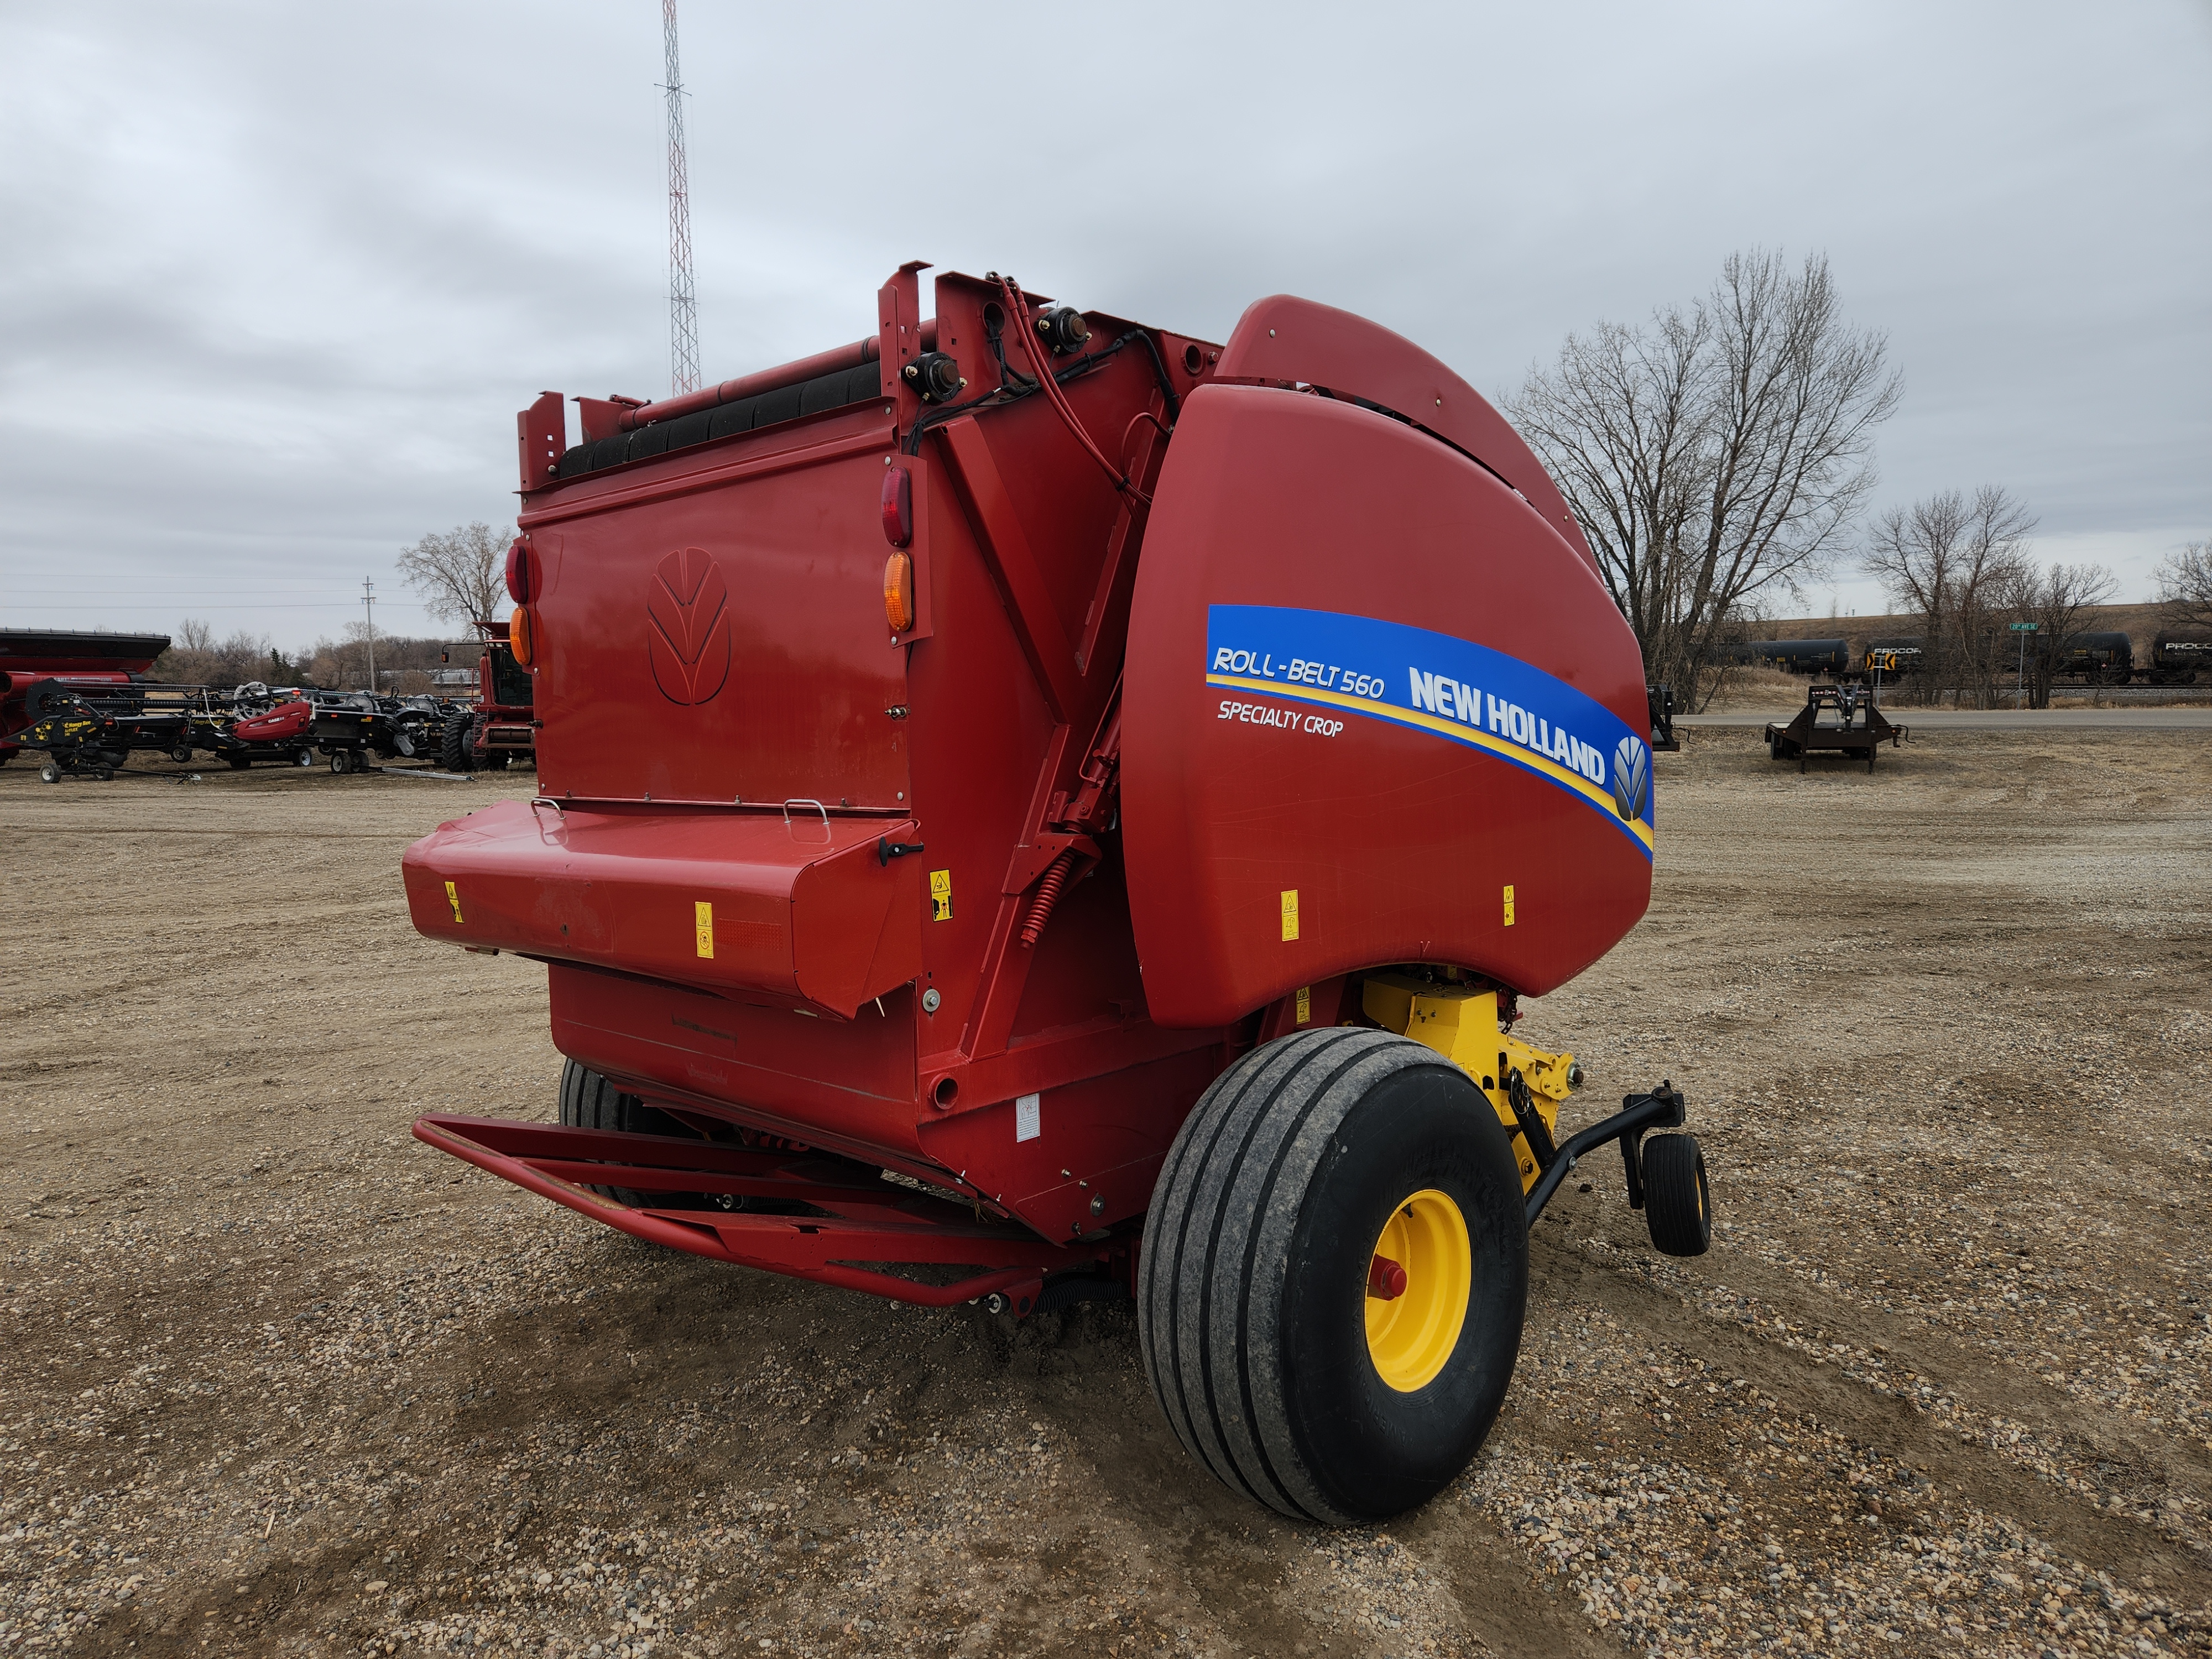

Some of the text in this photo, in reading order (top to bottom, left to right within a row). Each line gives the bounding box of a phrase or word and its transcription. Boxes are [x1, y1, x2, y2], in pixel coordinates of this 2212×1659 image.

[1340, 670, 1385, 699] 560
[1217, 701, 1344, 738] SPECIALTY CROP
[1409, 666, 1606, 786] NEW HOLLAND
